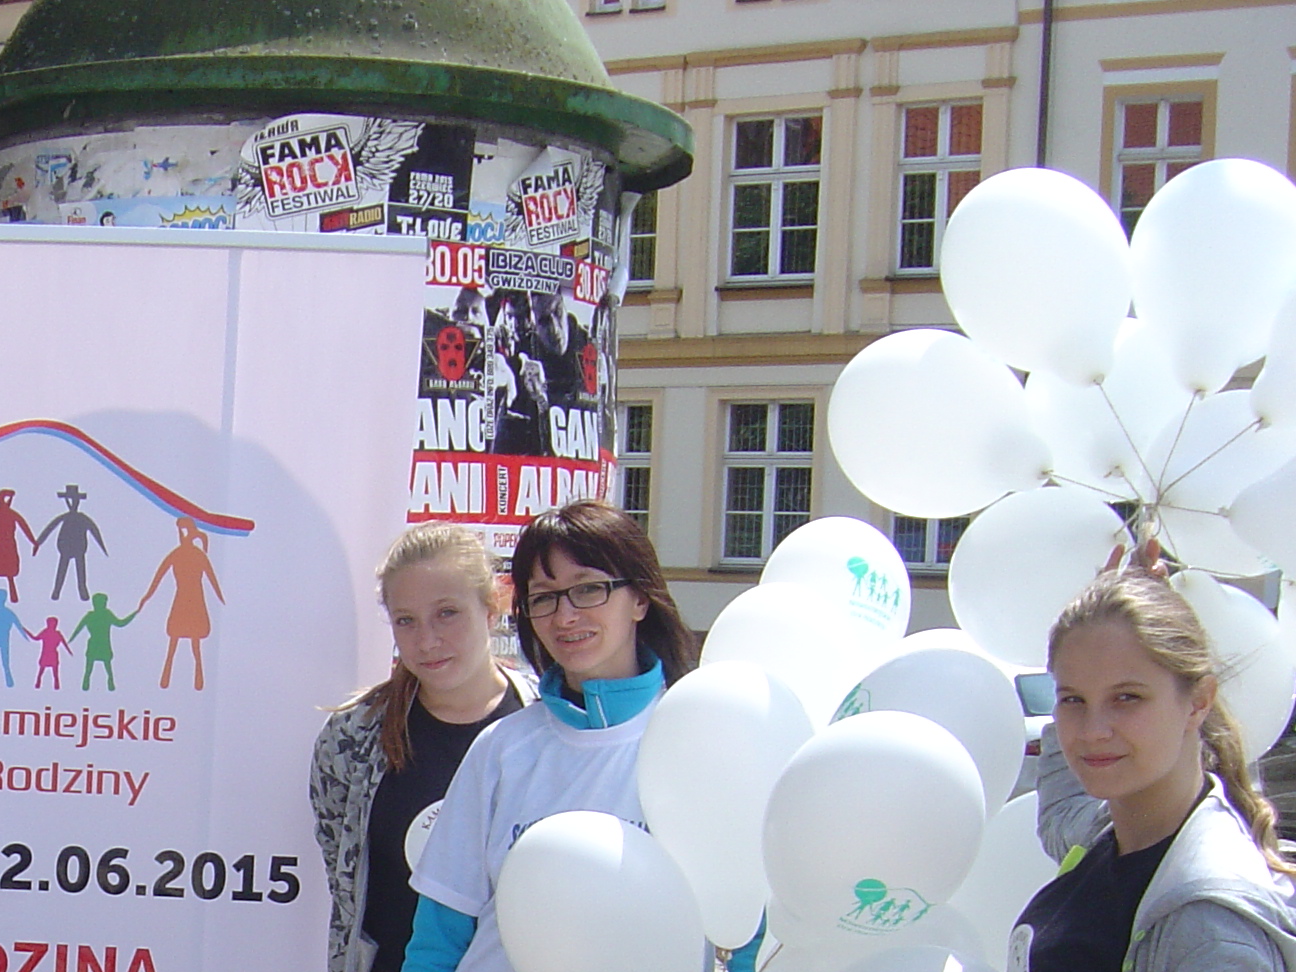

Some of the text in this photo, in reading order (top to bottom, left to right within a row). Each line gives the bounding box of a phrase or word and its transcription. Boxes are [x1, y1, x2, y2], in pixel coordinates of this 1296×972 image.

[258, 131, 346, 166] FAMA
[263, 150, 354, 200] ROCK
[520, 166, 574, 195] FAMA
[269, 184, 356, 215] FESTIWAL
[524, 186, 577, 228] ROCK
[349, 206, 383, 228] RADIO
[529, 218, 578, 243] FESTIWAL
[489, 249, 538, 274] IBIZA
[538, 257, 575, 280] CLUB
[549, 405, 599, 461] GAN
